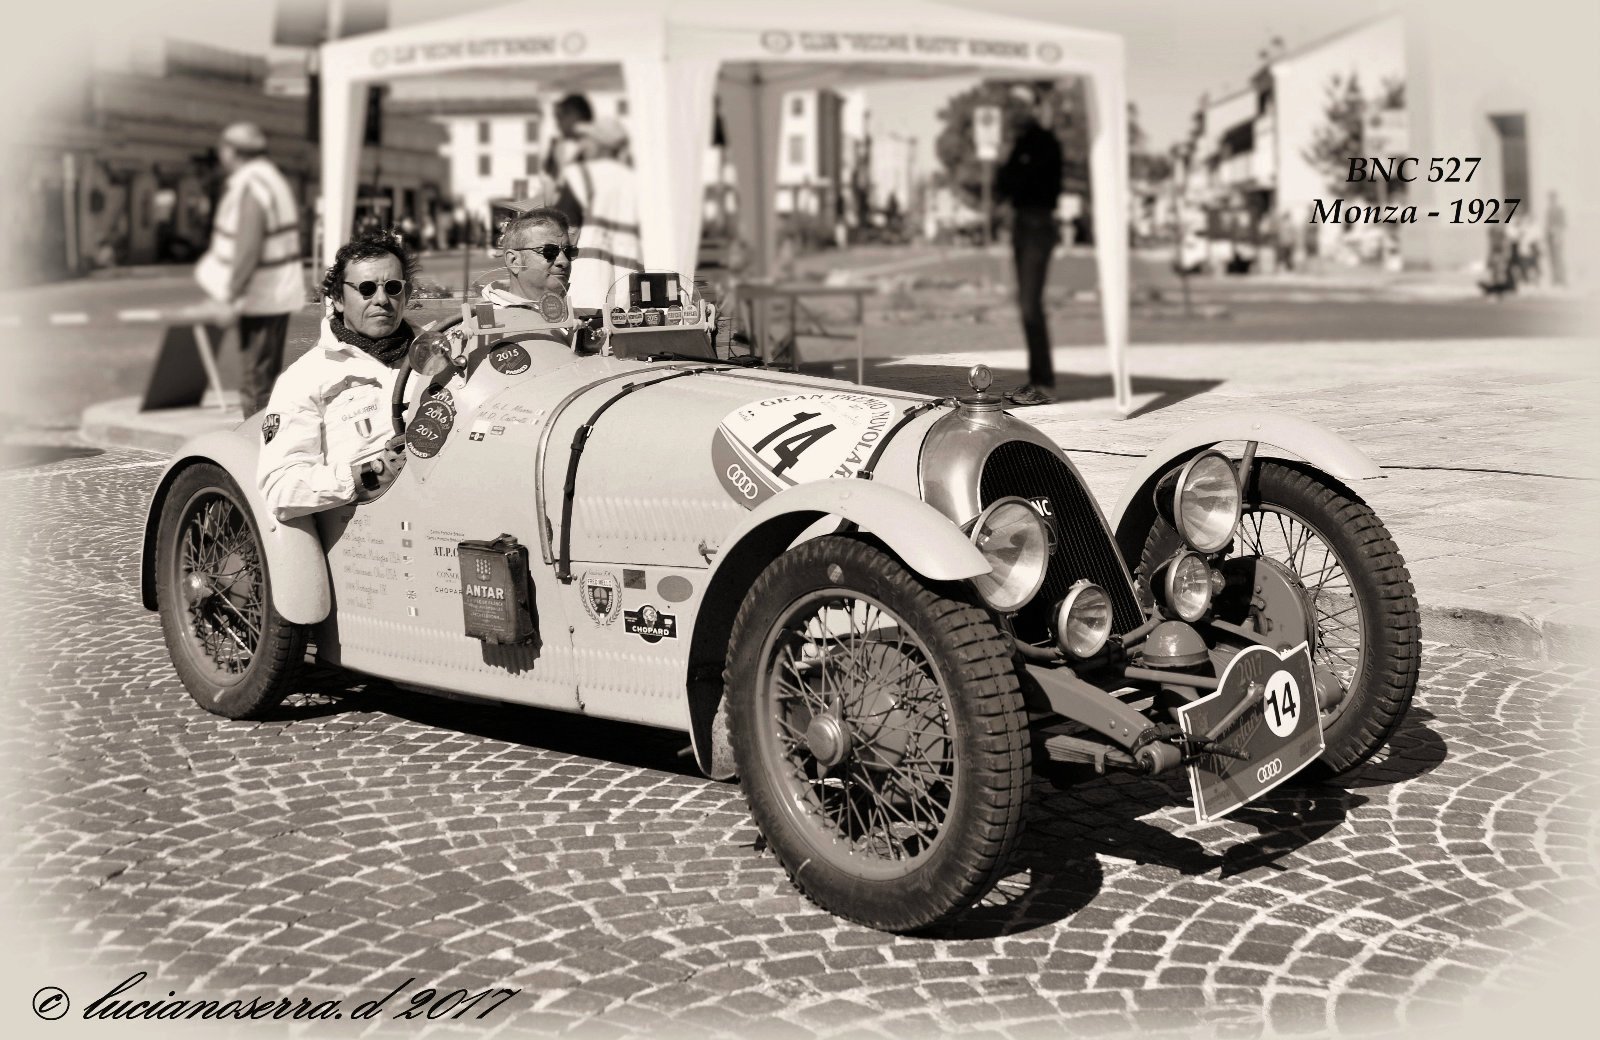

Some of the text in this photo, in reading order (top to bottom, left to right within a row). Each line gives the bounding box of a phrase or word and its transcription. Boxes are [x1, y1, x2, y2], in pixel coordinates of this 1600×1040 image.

[496, 348, 519, 362] 2015
[425, 407, 448, 424] 2016
[415, 424, 439, 441] 2017
[760, 394, 824, 407] GRAN
[829, 410, 890, 479] NUVOLAR
[752, 411, 837, 478] 14
[1030, 499, 1052, 517] NC
[434, 586, 462, 594] CHOPAR
[465, 584, 504, 600] ANTAR
[631, 625, 670, 636] CHOPARD
[1235, 652, 1264, 686] 2017
[1267, 681, 1297, 729] 14
